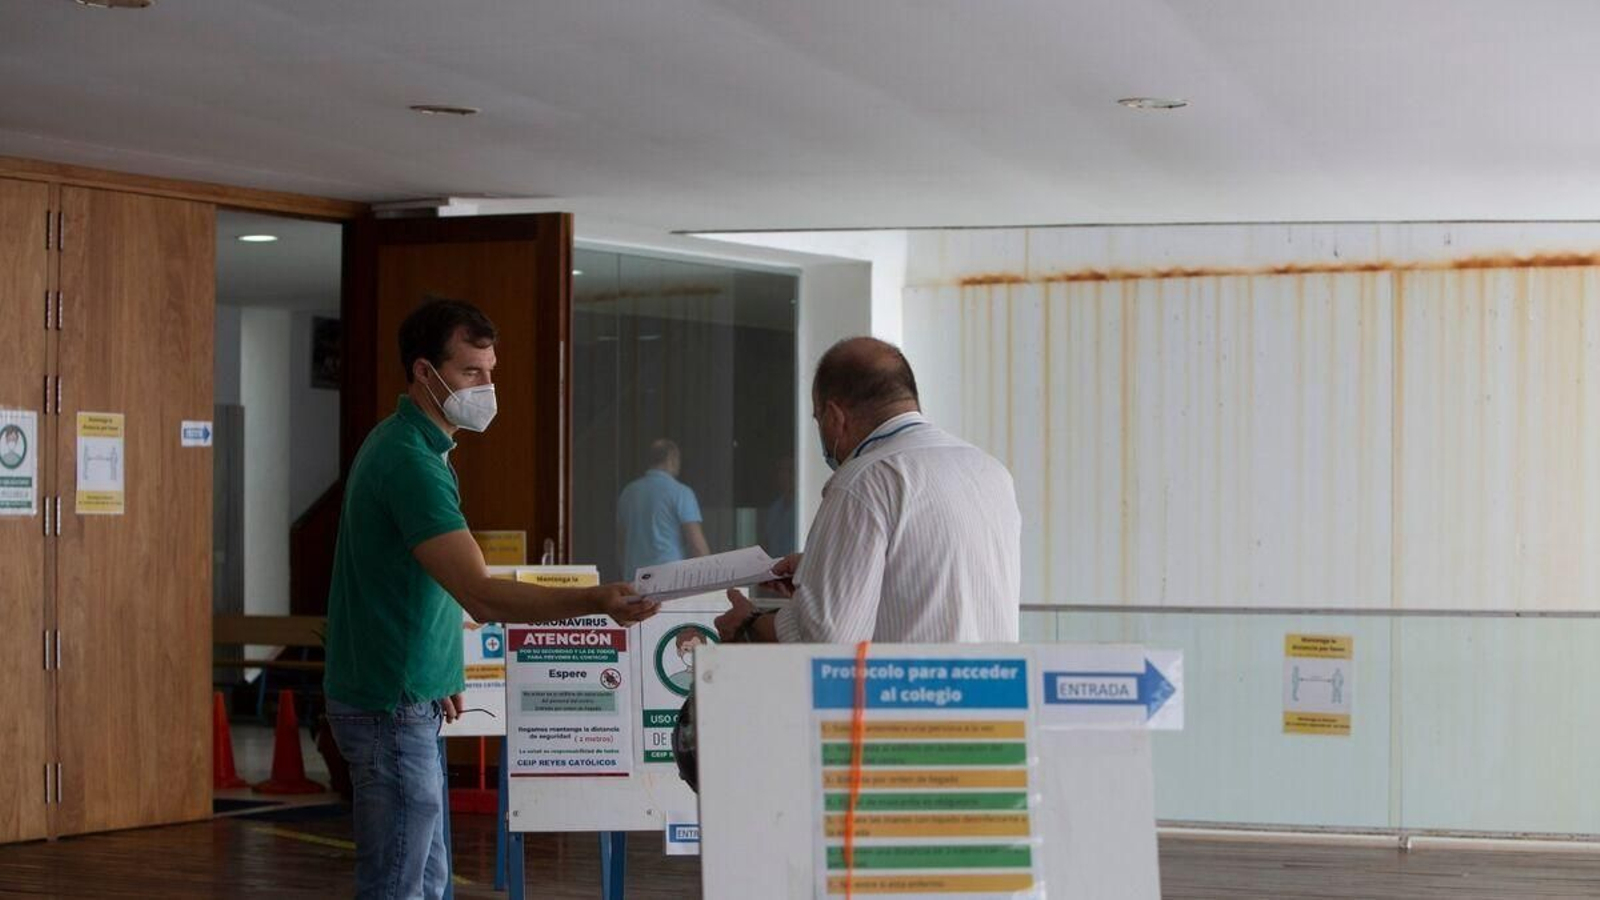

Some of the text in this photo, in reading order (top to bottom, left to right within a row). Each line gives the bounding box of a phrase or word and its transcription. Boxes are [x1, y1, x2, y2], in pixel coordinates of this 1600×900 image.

[523, 631, 612, 646] ATENCIÓN
[548, 669, 587, 679] Espere
[908, 666, 948, 683] para
[951, 664, 1019, 680] acceder
[880, 687, 963, 706] al colegio
[1059, 682, 1130, 697] ENTRADA
[651, 715, 671, 724] USO
[652, 732, 667, 746] DE
[568, 758, 617, 766] CATÓLICOS
[677, 829, 700, 838] ENTR
